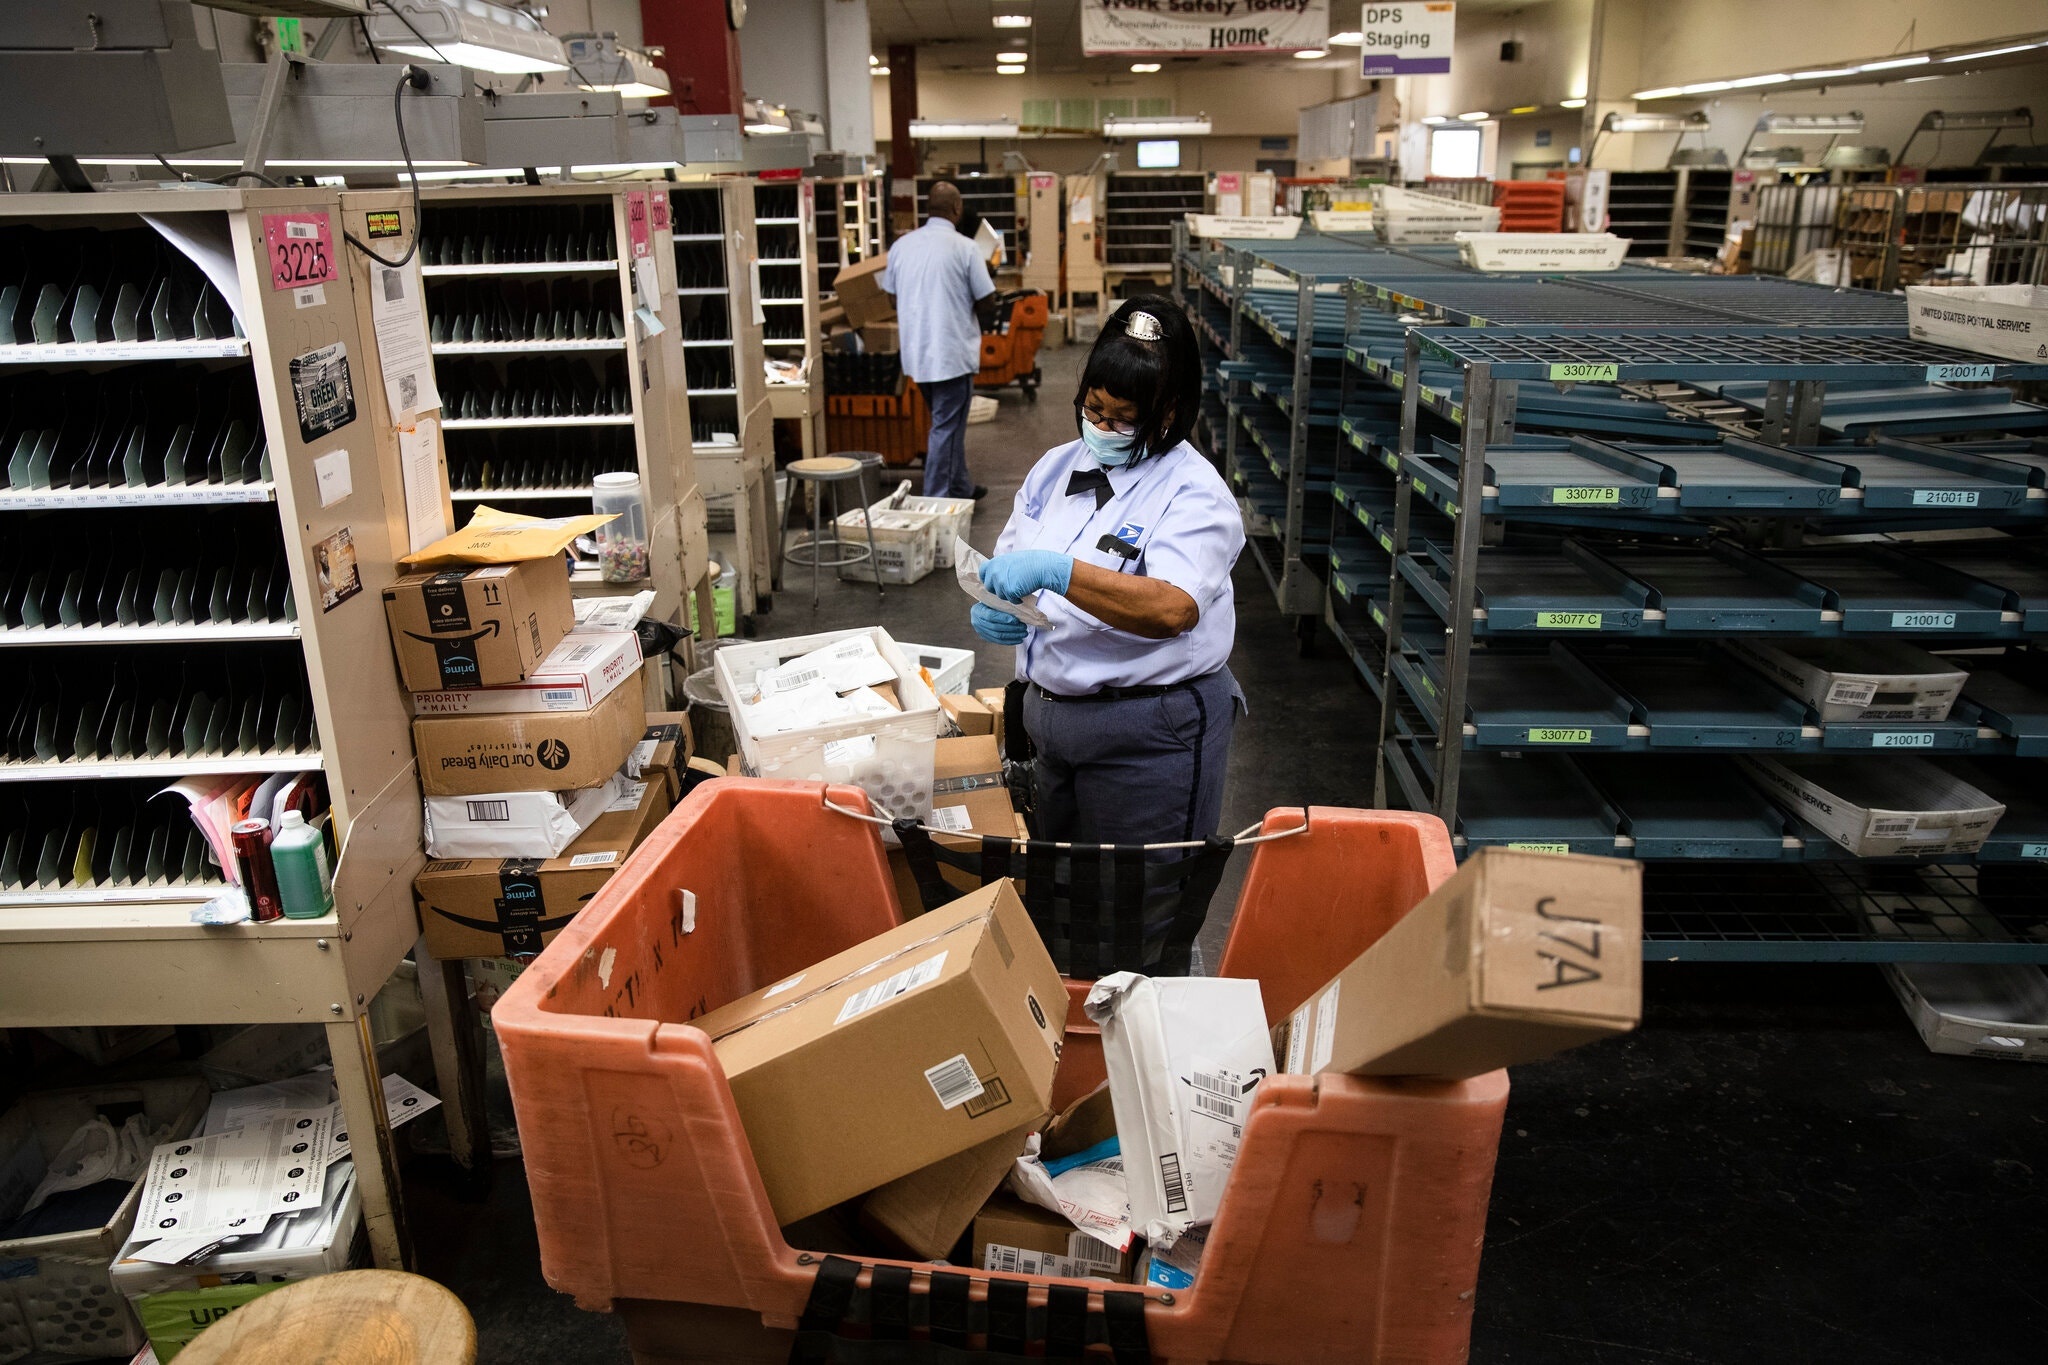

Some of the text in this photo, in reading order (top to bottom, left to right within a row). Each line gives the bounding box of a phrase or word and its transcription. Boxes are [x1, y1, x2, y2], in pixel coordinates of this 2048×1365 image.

[1367, 8, 1402, 23] DPS
[1210, 26, 1270, 48] Home
[1366, 31, 1430, 49] Staging
[277, 241, 328, 283] 3225
[1921, 306, 1942, 320] UNITED
[1943, 310, 1966, 325] STATES
[1996, 319, 2031, 333] SERVICE
[1563, 365, 1613, 376] 33077 A
[1939, 366, 1991, 378] 21001 A
[310, 380, 338, 408] GREEN
[1566, 489, 1614, 499] 33077 B
[1631, 487, 1652, 504] 84
[1926, 492, 1976, 503] 21001 B
[1549, 614, 1597, 625] 33077 C
[1904, 615, 1954, 626] 21001 C
[445, 663, 476, 675] prime
[602, 653, 624, 677] PRIORITY
[609, 669, 622, 682] MAIL
[416, 693, 469, 703] PRIORITY
[431, 704, 459, 712] MAIL
[1540, 730, 1587, 740] 33077 D
[1775, 731, 1795, 746] 82
[1885, 735, 1932, 745] 21001 D
[441, 753, 535, 771] Our Daily Bread
[1801, 791, 1833, 816] SERVICE
[506, 889, 536, 901] prime
[1536, 897, 1602, 991] J7A
